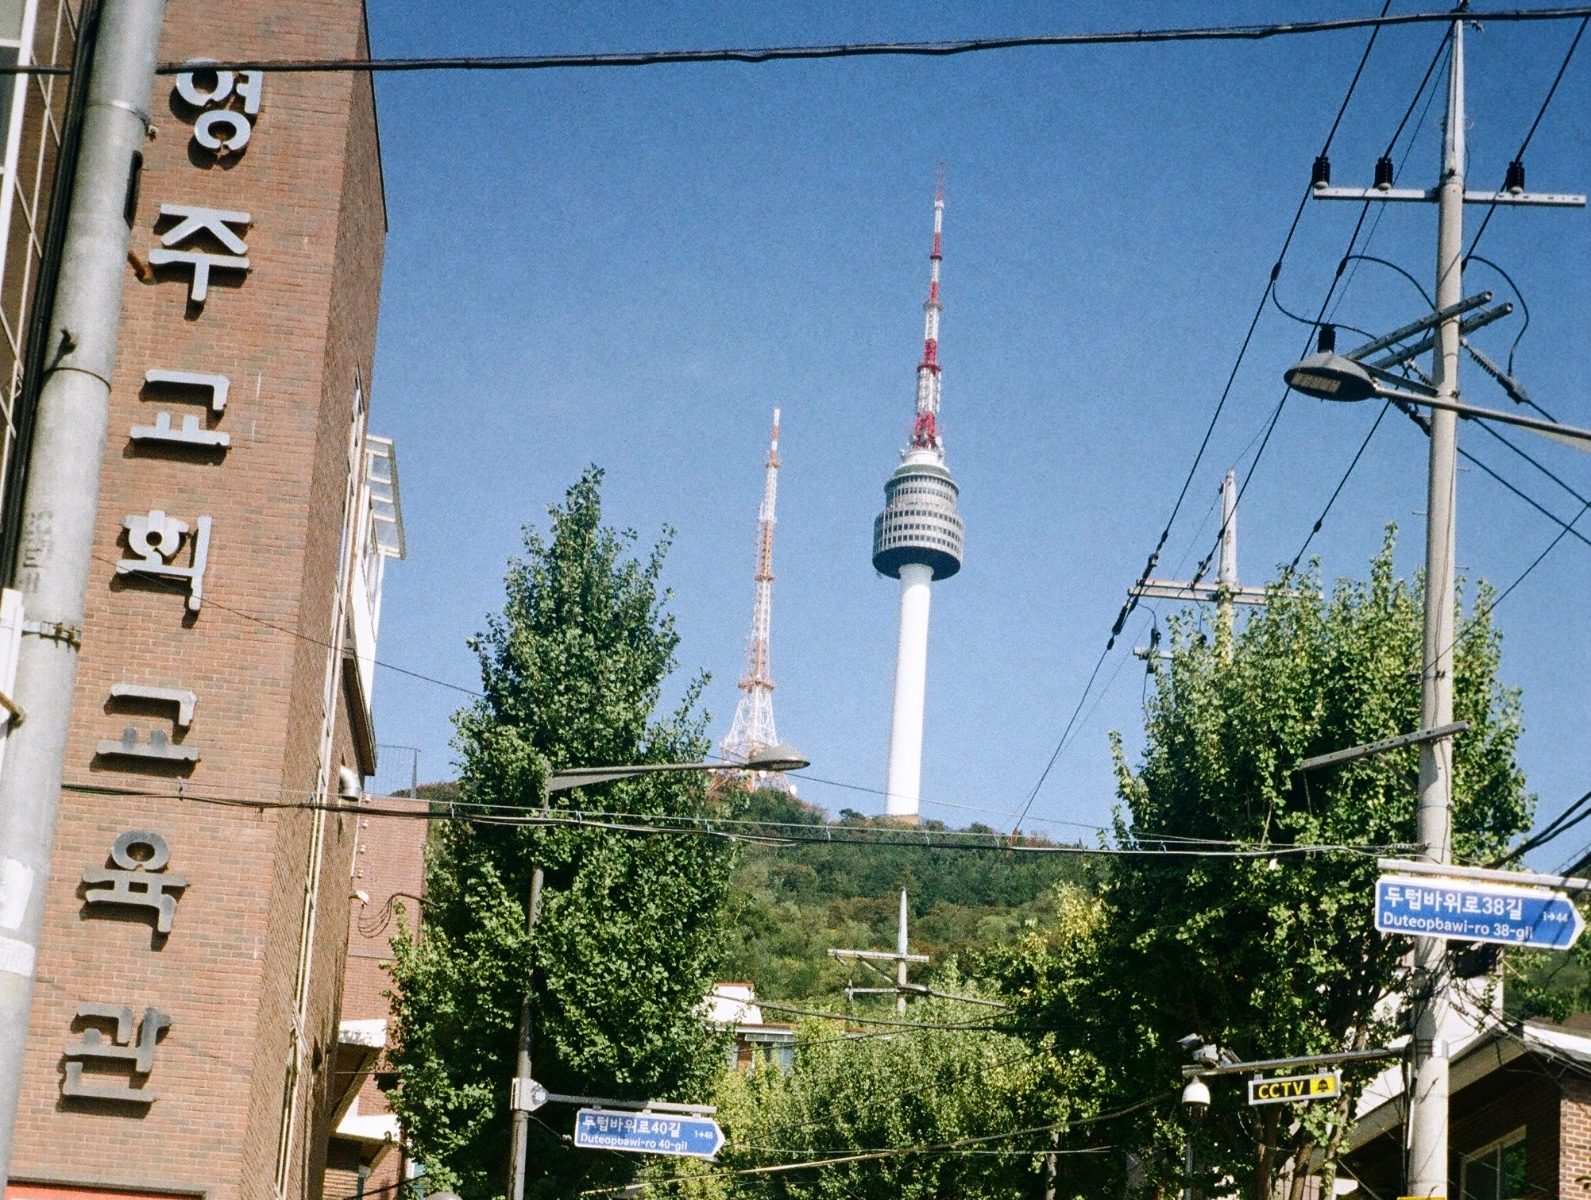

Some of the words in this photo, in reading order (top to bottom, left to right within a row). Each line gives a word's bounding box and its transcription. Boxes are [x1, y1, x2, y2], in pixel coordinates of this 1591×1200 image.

[1385, 886, 1523, 921] 두텁바위로38길
[1383, 912, 1490, 935] Duteopbawi-ro
[1493, 924, 1533, 940] 38-gil
[1258, 1081, 1304, 1099] CCTV
[582, 1116, 681, 1138] 두텁바위로40길
[580, 1133, 656, 1148] Duteopbawi-ro
[658, 1139, 687, 1152] 40-gil
